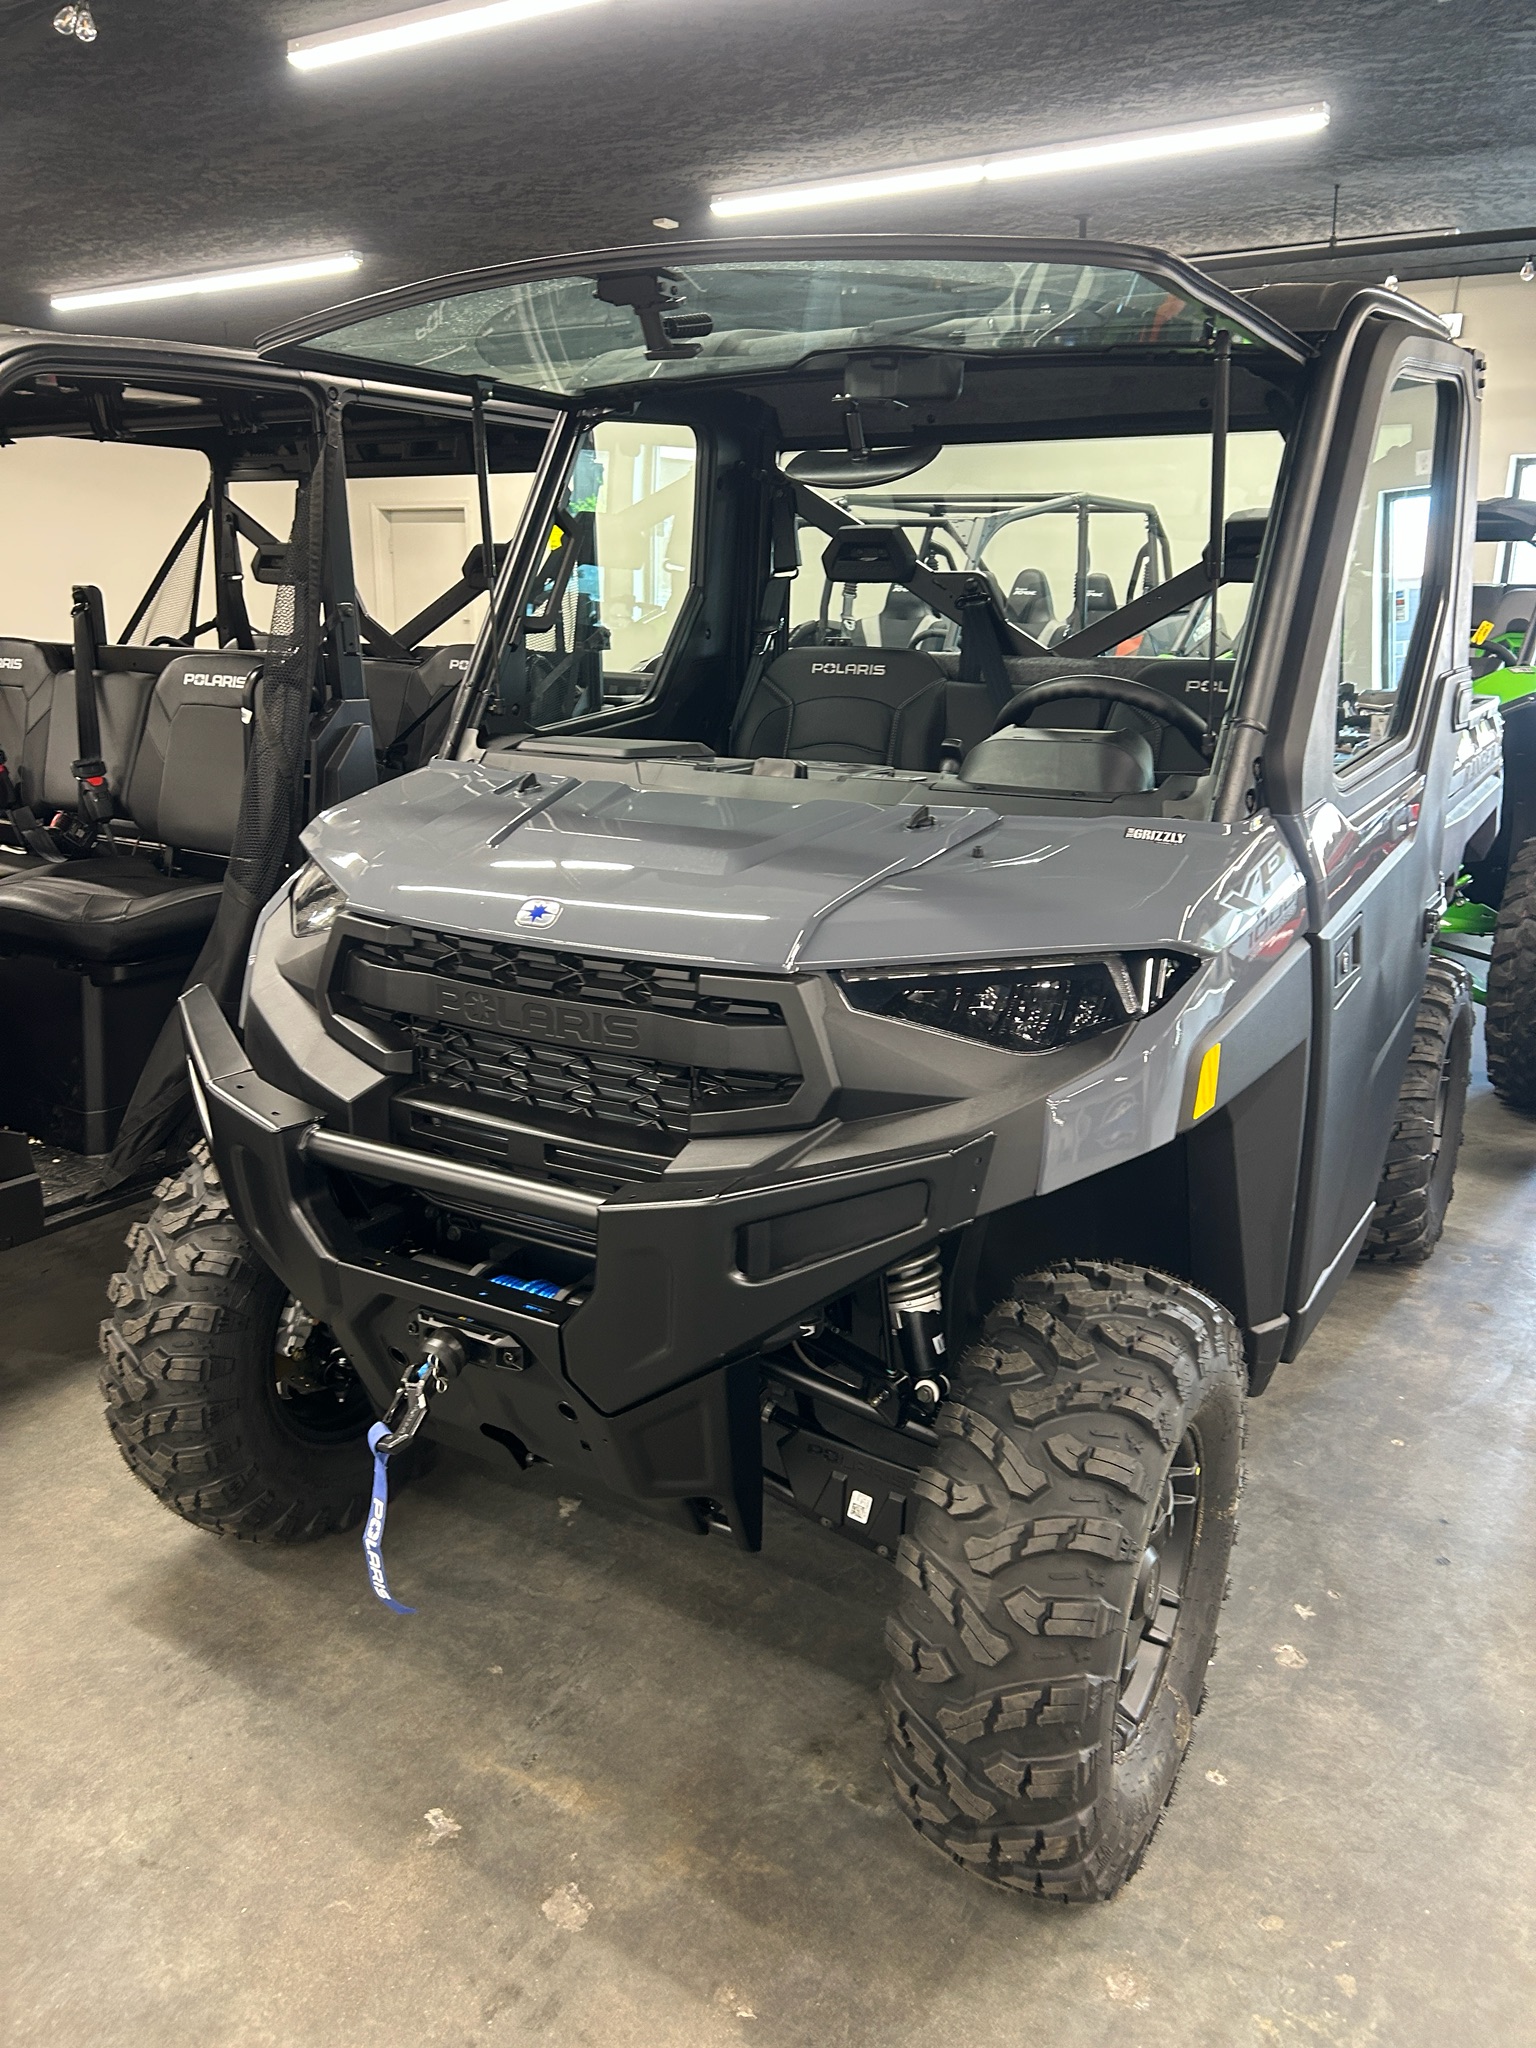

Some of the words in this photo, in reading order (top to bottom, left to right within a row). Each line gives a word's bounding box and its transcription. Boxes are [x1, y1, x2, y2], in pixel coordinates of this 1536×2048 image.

[811, 662, 886, 676] POLARIS
[183, 673, 246, 689] POLARIS
[1133, 828, 1187, 844] GRIZZLY
[436, 984, 640, 1049] POLARIS
[364, 1497, 392, 1600] POLARIS
